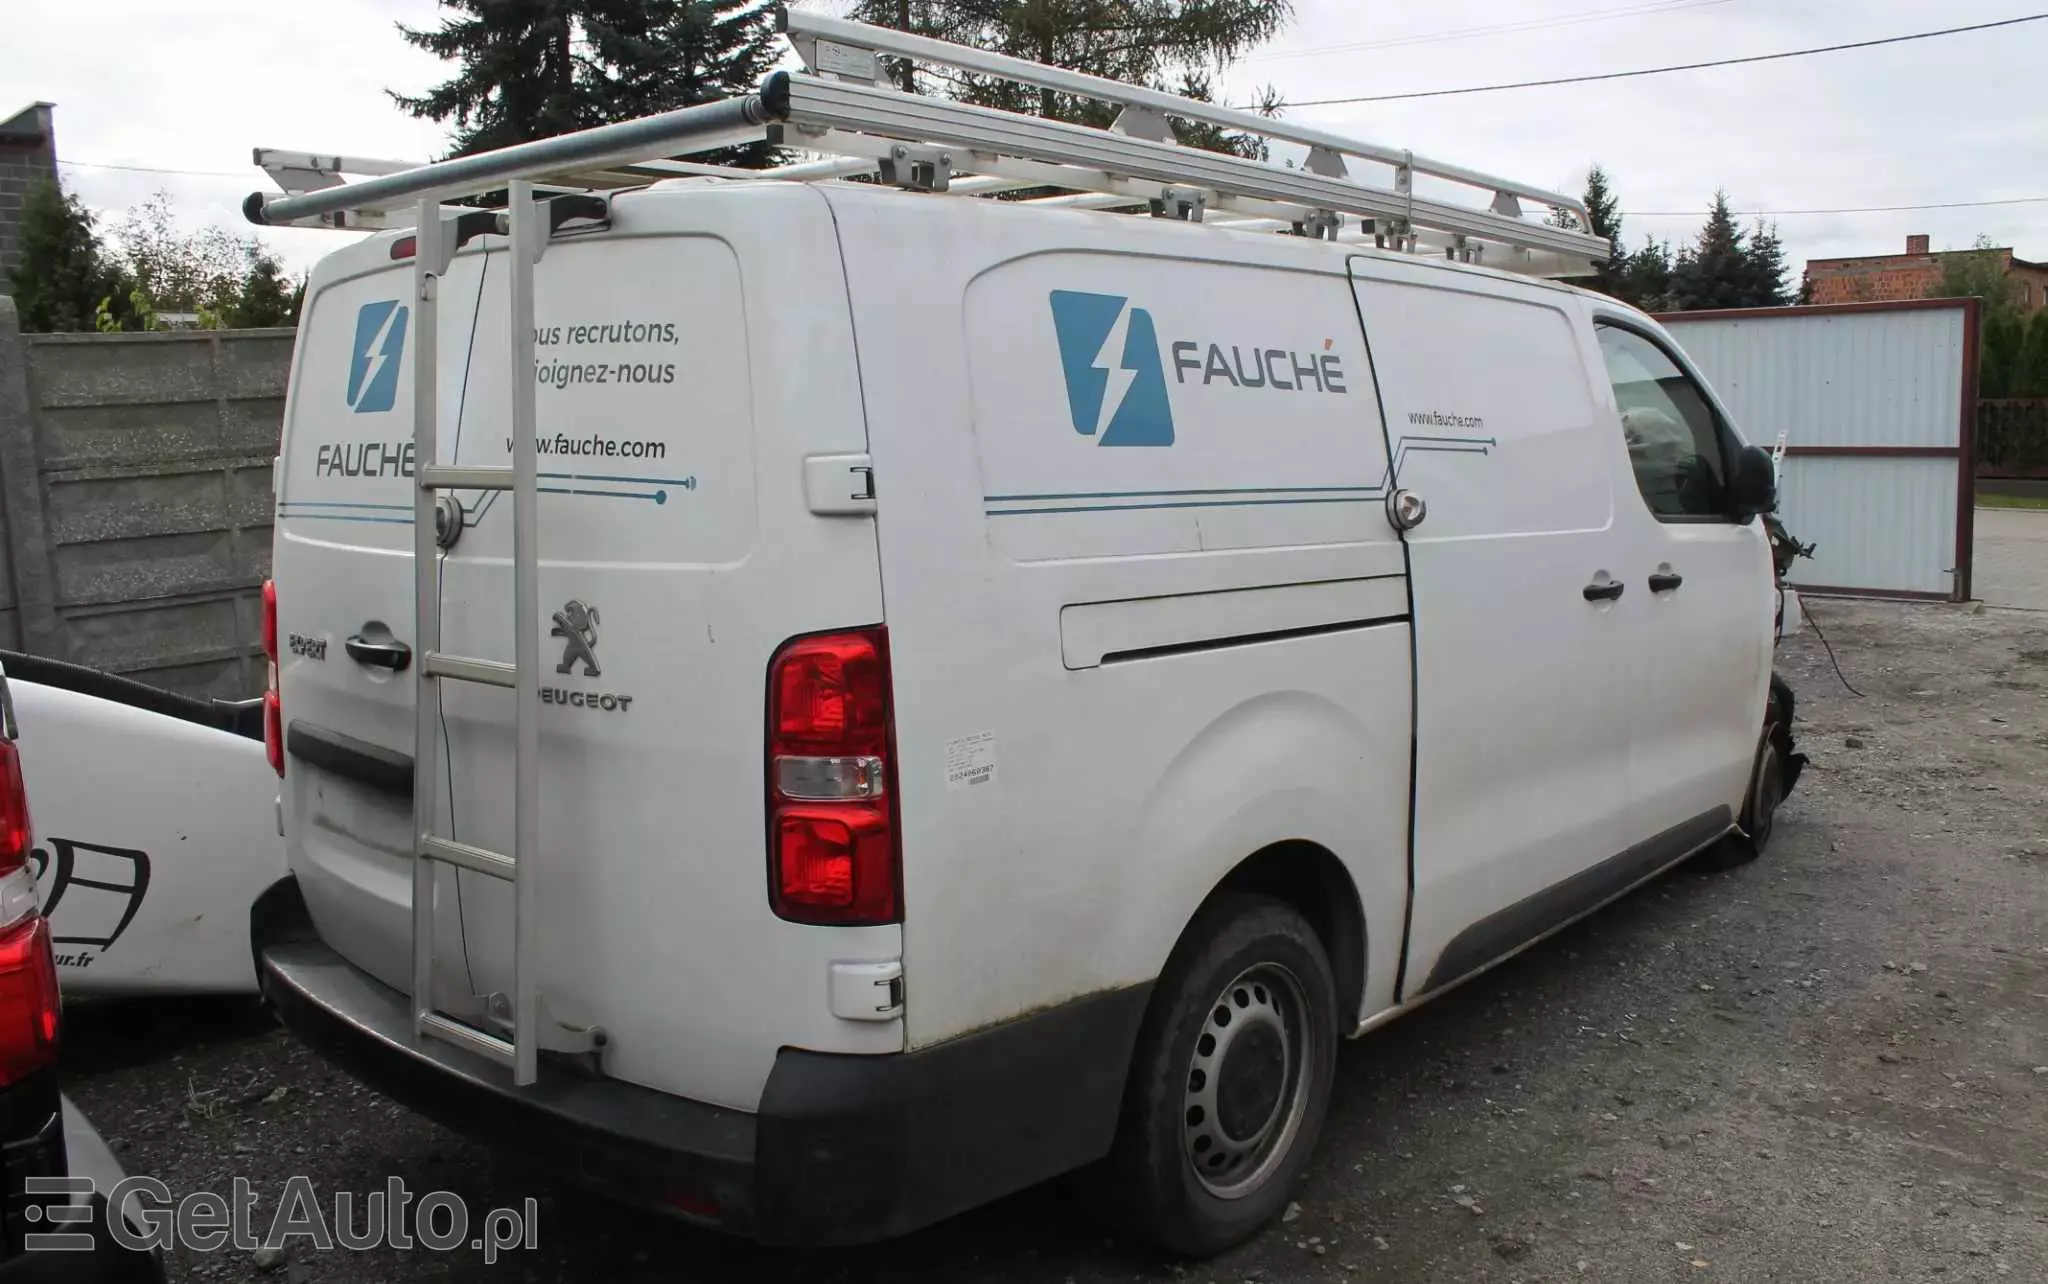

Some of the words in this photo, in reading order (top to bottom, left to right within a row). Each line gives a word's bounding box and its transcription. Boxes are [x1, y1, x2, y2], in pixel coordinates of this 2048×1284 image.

[534, 327, 561, 345] us
[566, 320, 679, 345] recrutons,
[534, 358, 676, 390] joignez-nous
[1171, 337, 1347, 394] FAUCHÉ
[1408, 410, 1484, 429] www.fauche.com
[505, 433, 666, 459] ww.fauche.com
[537, 687, 633, 713] EUGEOT
